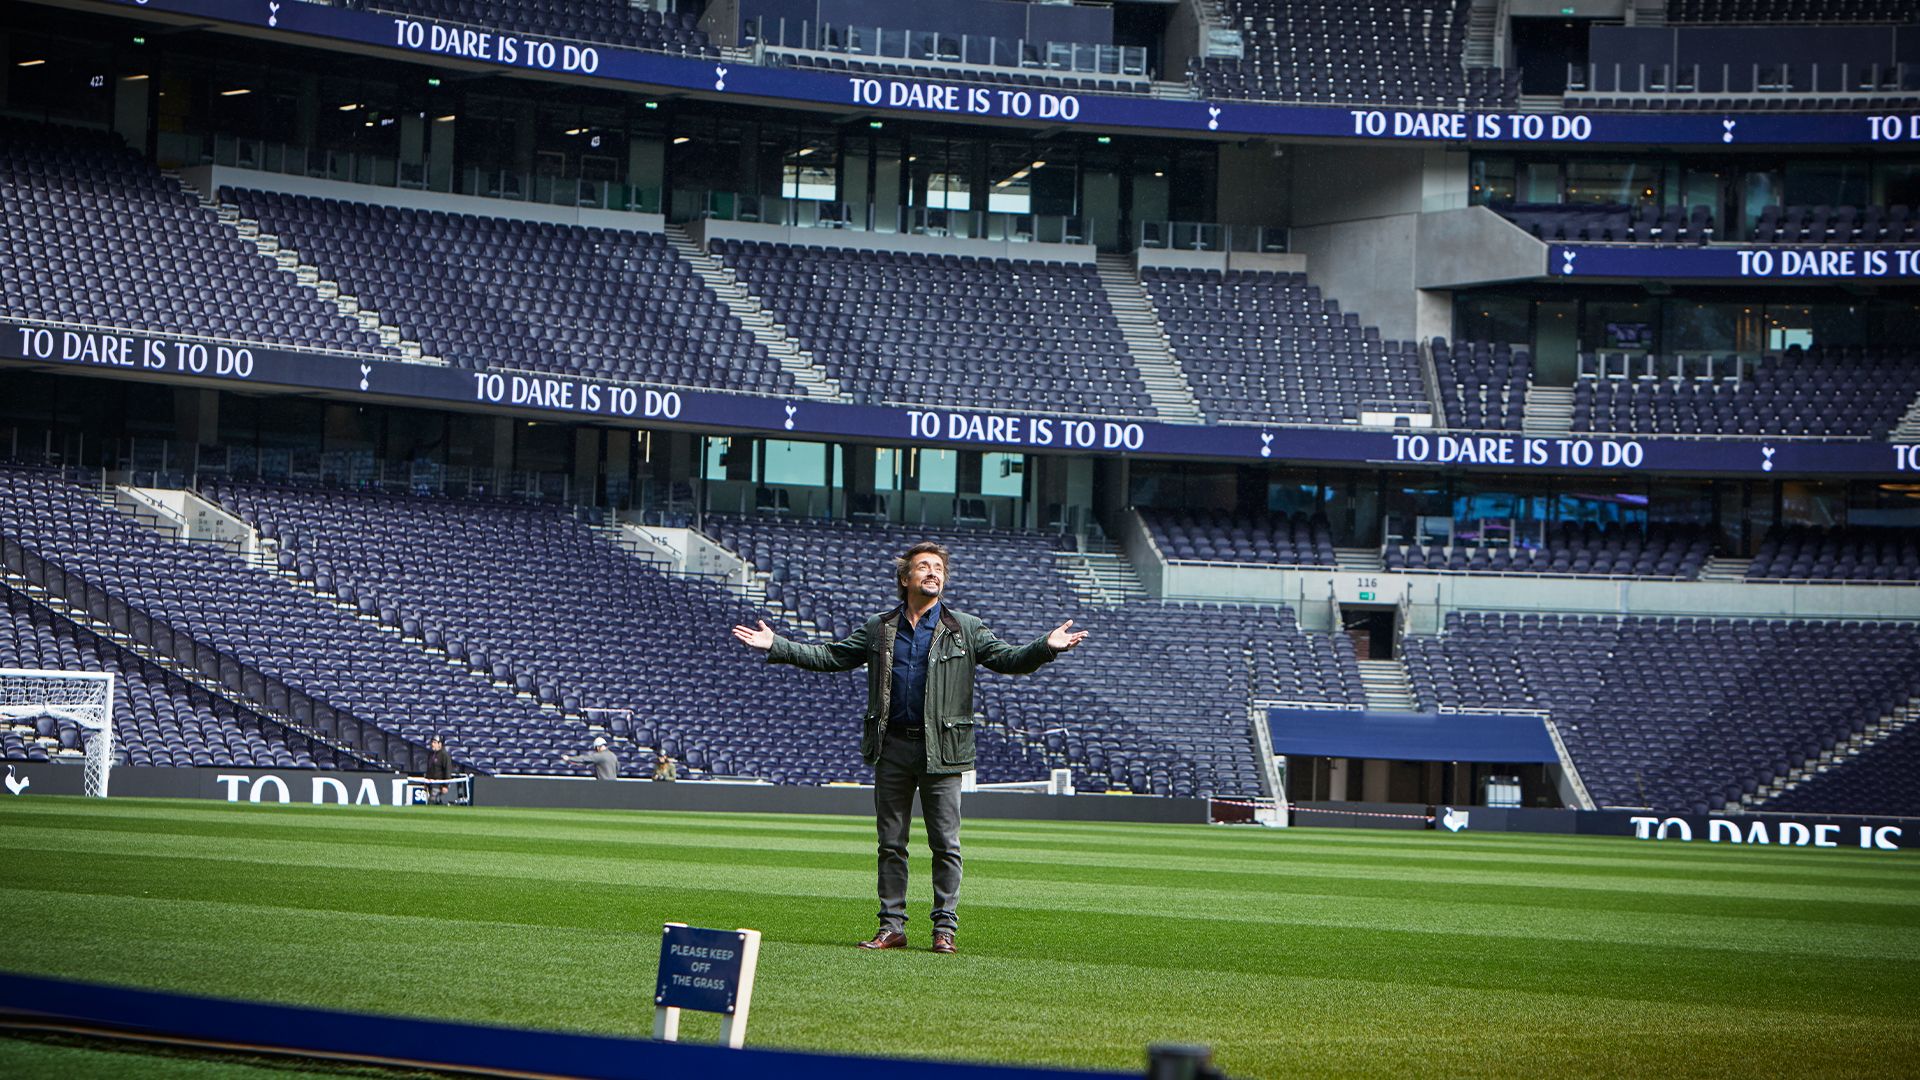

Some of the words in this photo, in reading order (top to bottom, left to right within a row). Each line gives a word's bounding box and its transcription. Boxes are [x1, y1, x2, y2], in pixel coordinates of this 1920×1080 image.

[394, 19, 424, 48] TO
[430, 25, 491, 59] DARE
[497, 36, 518, 63] IS
[523, 40, 556, 68] TO
[562, 45, 599, 73] DO
[849, 78, 882, 105] TO
[889, 81, 960, 111] DARE
[967, 88, 991, 113] IS
[997, 90, 1032, 116] TO
[1039, 93, 1080, 120] DO
[1350, 110, 1387, 136] TO
[1394, 111, 1467, 138] DARE
[1477, 114, 1501, 139] IS
[1508, 114, 1544, 139] TO
[1551, 115, 1592, 140] DO
[1867, 115, 1902, 140] TO
[1737, 250, 1773, 275] TO
[1781, 250, 1856, 275] DARE
[1863, 250, 1888, 275] IS
[18, 327, 54, 358] TO
[62, 331, 135, 366] DARE
[143, 339, 166, 369] IS
[174, 342, 208, 373] TO
[216, 346, 254, 377] DO
[473, 372, 505, 402] TO
[511, 376, 574, 409] DARE
[580, 383, 601, 412] IS
[607, 386, 638, 415] TO
[644, 390, 682, 419] DO
[906, 410, 941, 438] TO
[948, 413, 1022, 443] DARE
[1029, 418, 1053, 445] IS
[1060, 420, 1096, 447] TO
[1103, 422, 1144, 450] DO
[1392, 434, 1430, 461] TO
[1437, 436, 1515, 464] DARE
[1523, 438, 1548, 465] IS
[1556, 439, 1594, 466] TO
[1601, 440, 1644, 467] DO
[1357, 577, 1378, 588] 116
[670, 944, 708, 958] PLEASE
[709, 948, 734, 960] KEEP
[672, 974, 692, 986] THE
[693, 977, 726, 990] GRASS
[690, 962, 712, 973] OFF
